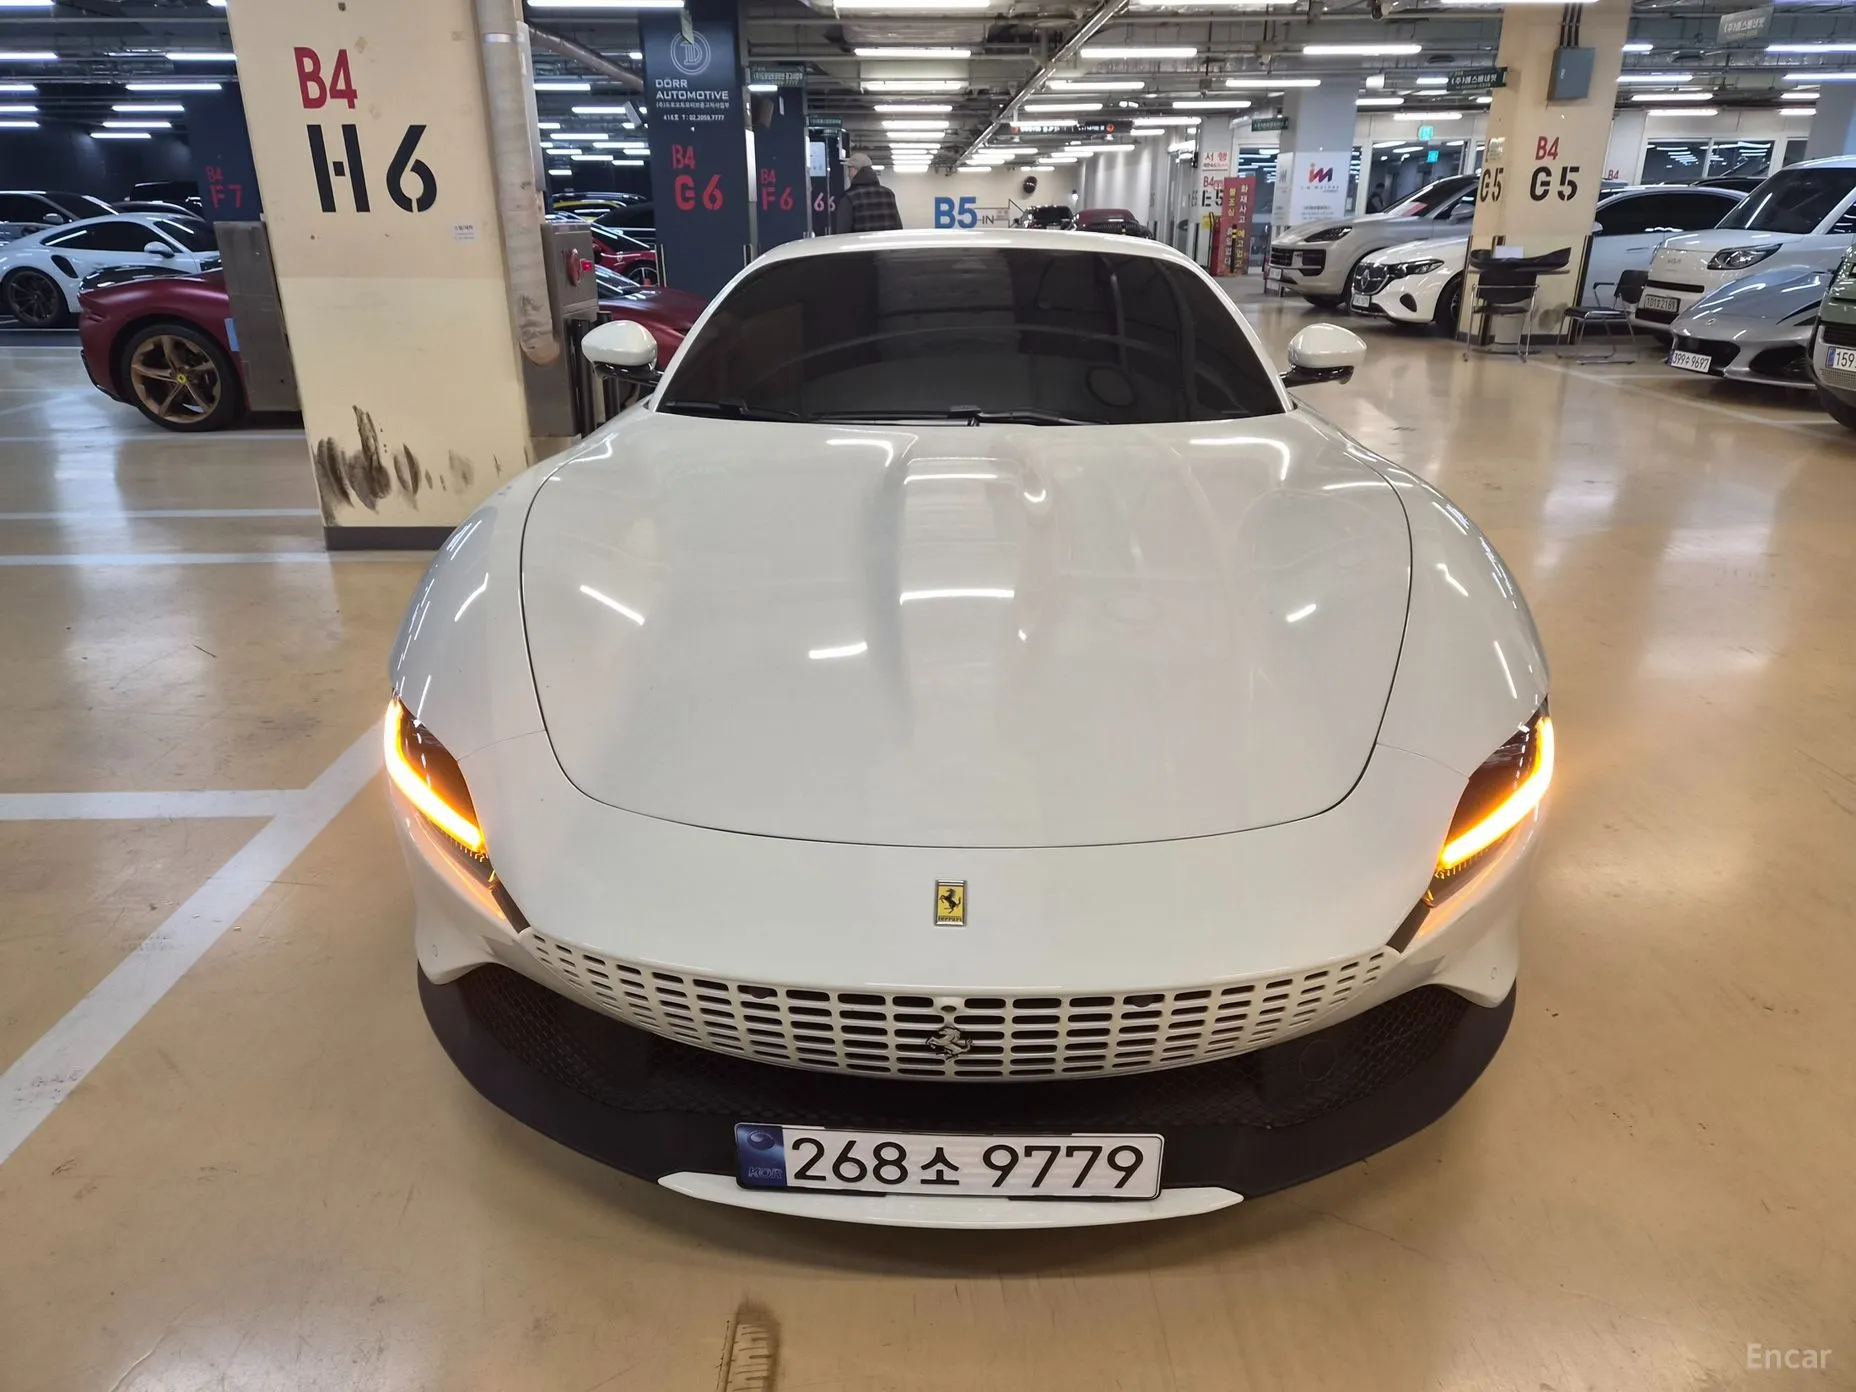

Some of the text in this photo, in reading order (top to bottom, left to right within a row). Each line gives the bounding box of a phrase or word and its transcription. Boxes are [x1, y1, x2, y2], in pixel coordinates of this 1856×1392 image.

[293, 46, 358, 109] B4
[656, 90, 729, 100] AUTOMOTIVE
[672, 144, 696, 169] B4
[1535, 136, 1560, 160] B4
[761, 169, 776, 184] B4
[934, 196, 978, 228] B5
[982, 214, 995, 225] IN
[1691, 355, 1710, 370] 9697
[1836, 351, 1856, 368] 159
[792, 1138, 1144, 1188] 268소 9779
